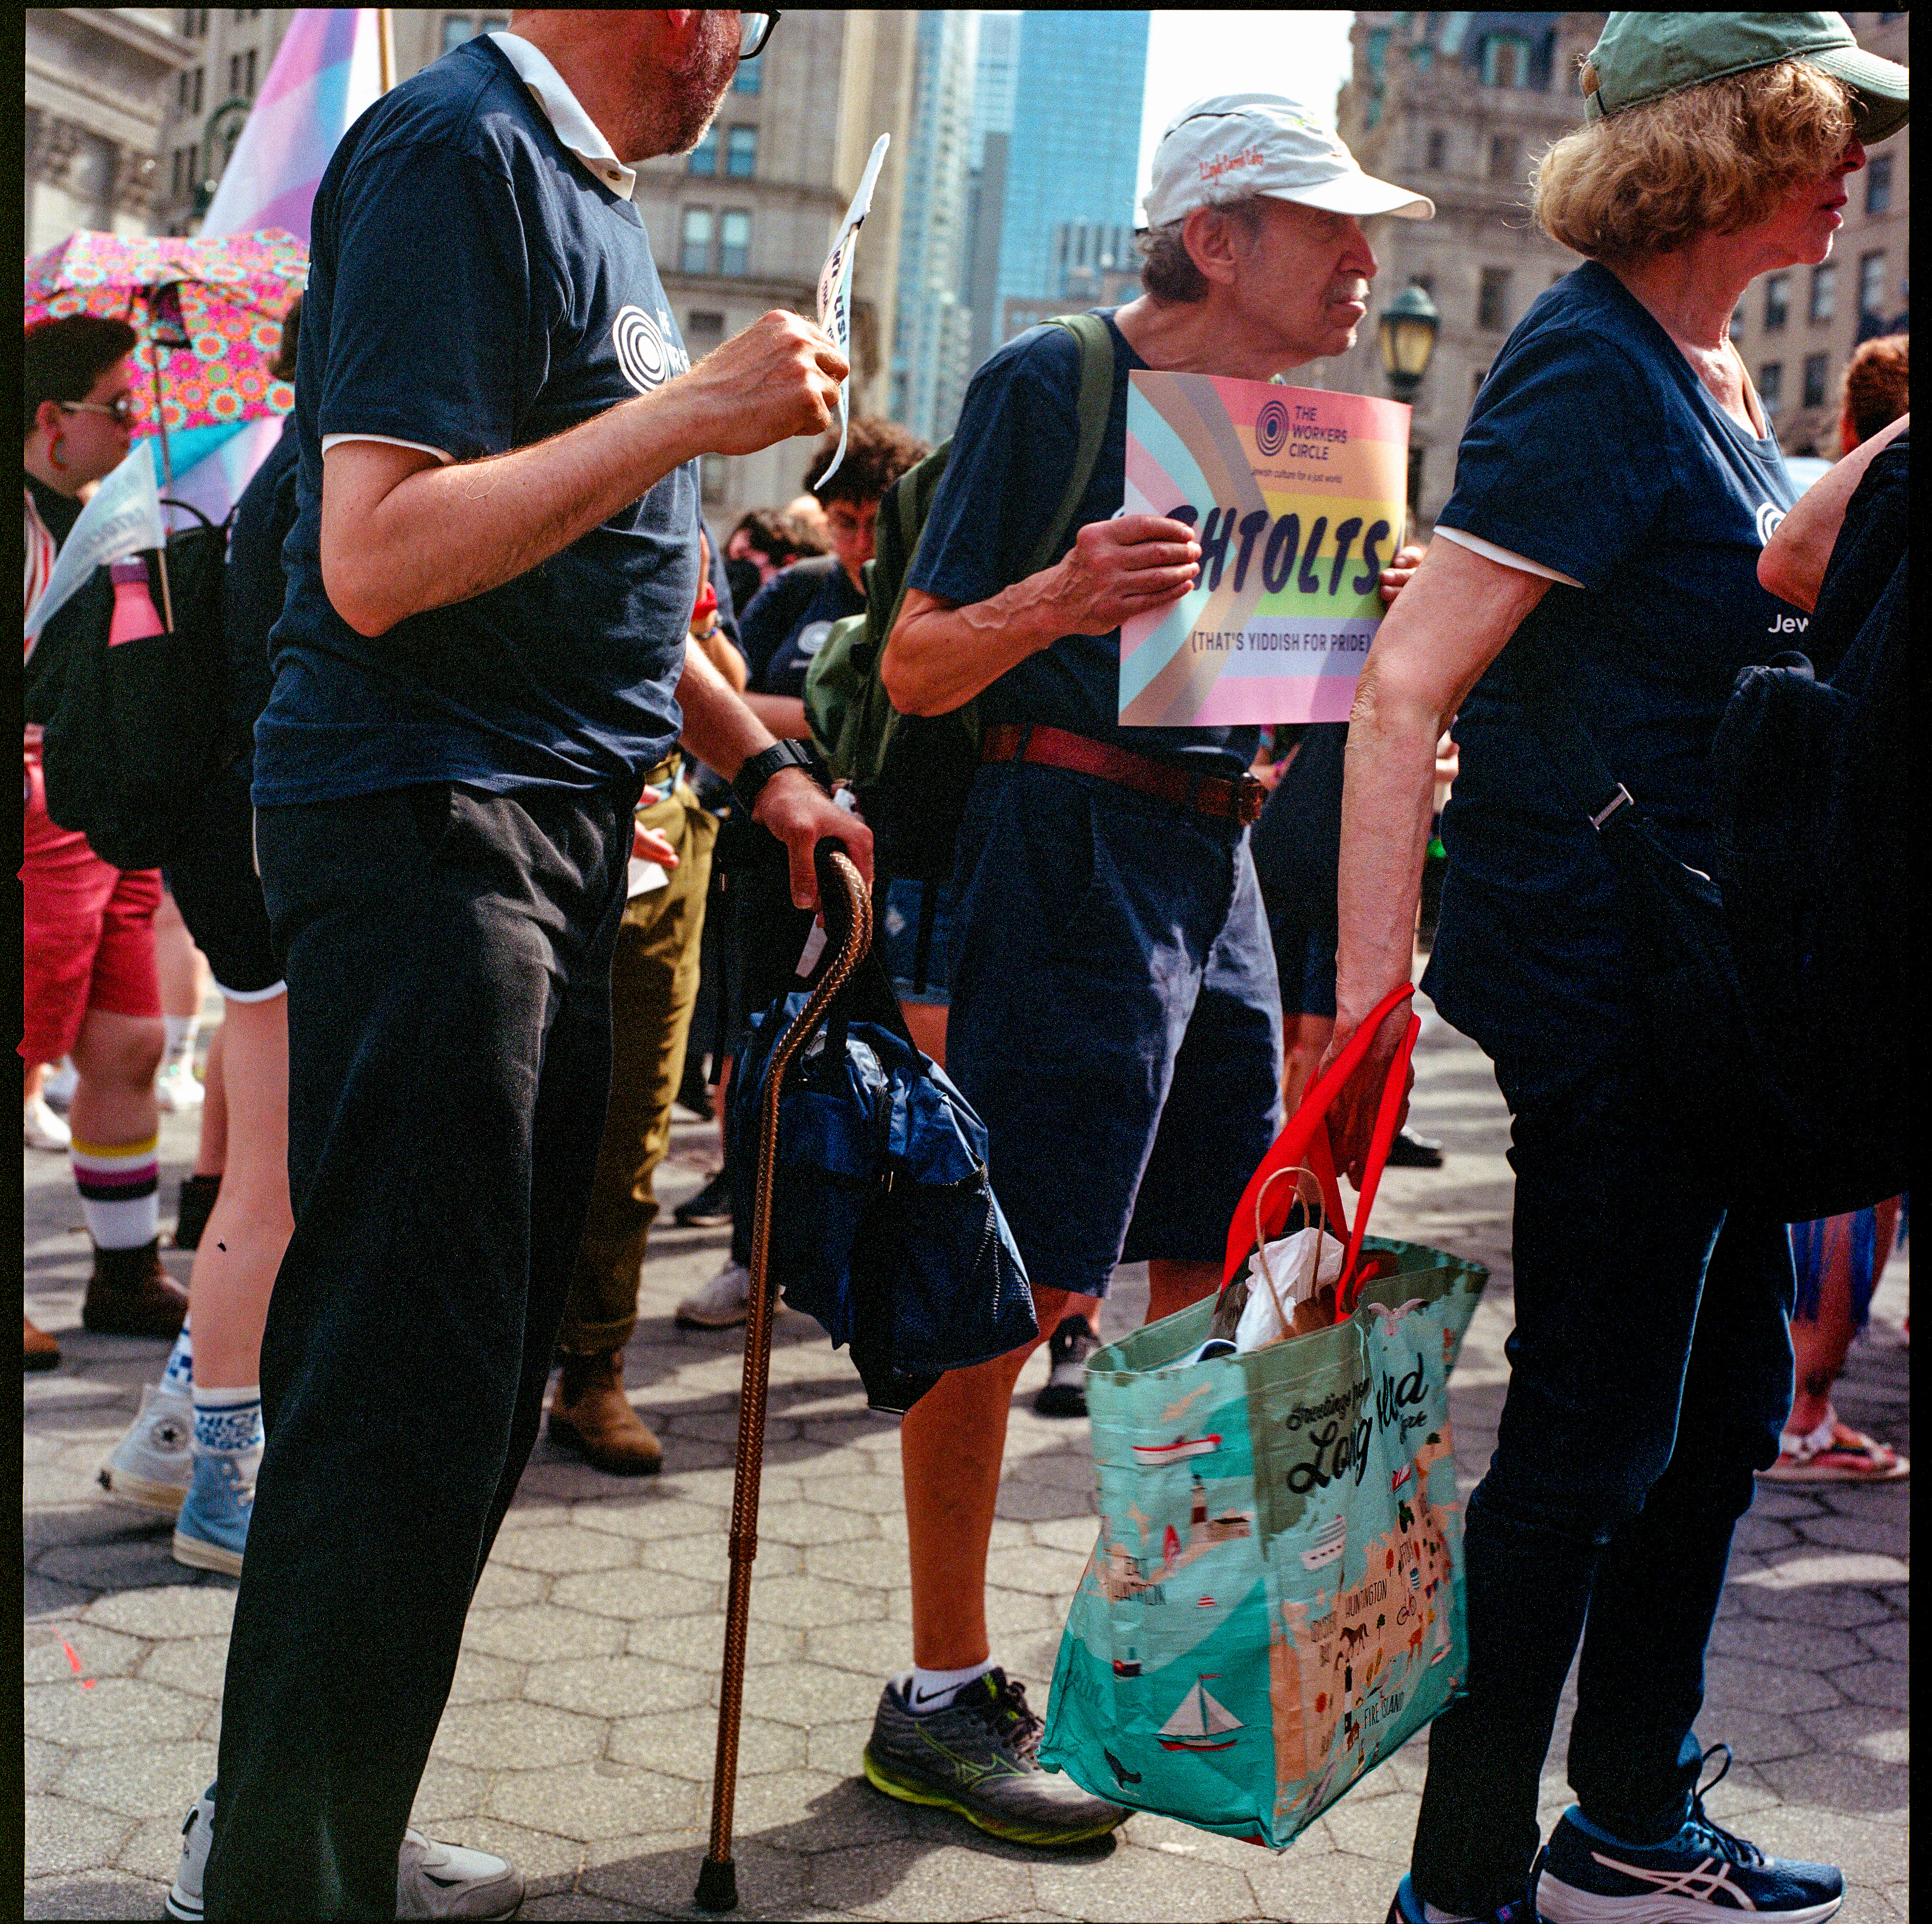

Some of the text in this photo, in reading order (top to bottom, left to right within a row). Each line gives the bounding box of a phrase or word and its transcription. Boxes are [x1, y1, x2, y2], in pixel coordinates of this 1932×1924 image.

[1296, 405, 1317, 421] THE
[1293, 424, 1348, 443] WORKERS
[1289, 443, 1329, 460] CIRCLE
[1192, 631, 1372, 654] (THAT'S YIDDISH FOR PRIDE)
